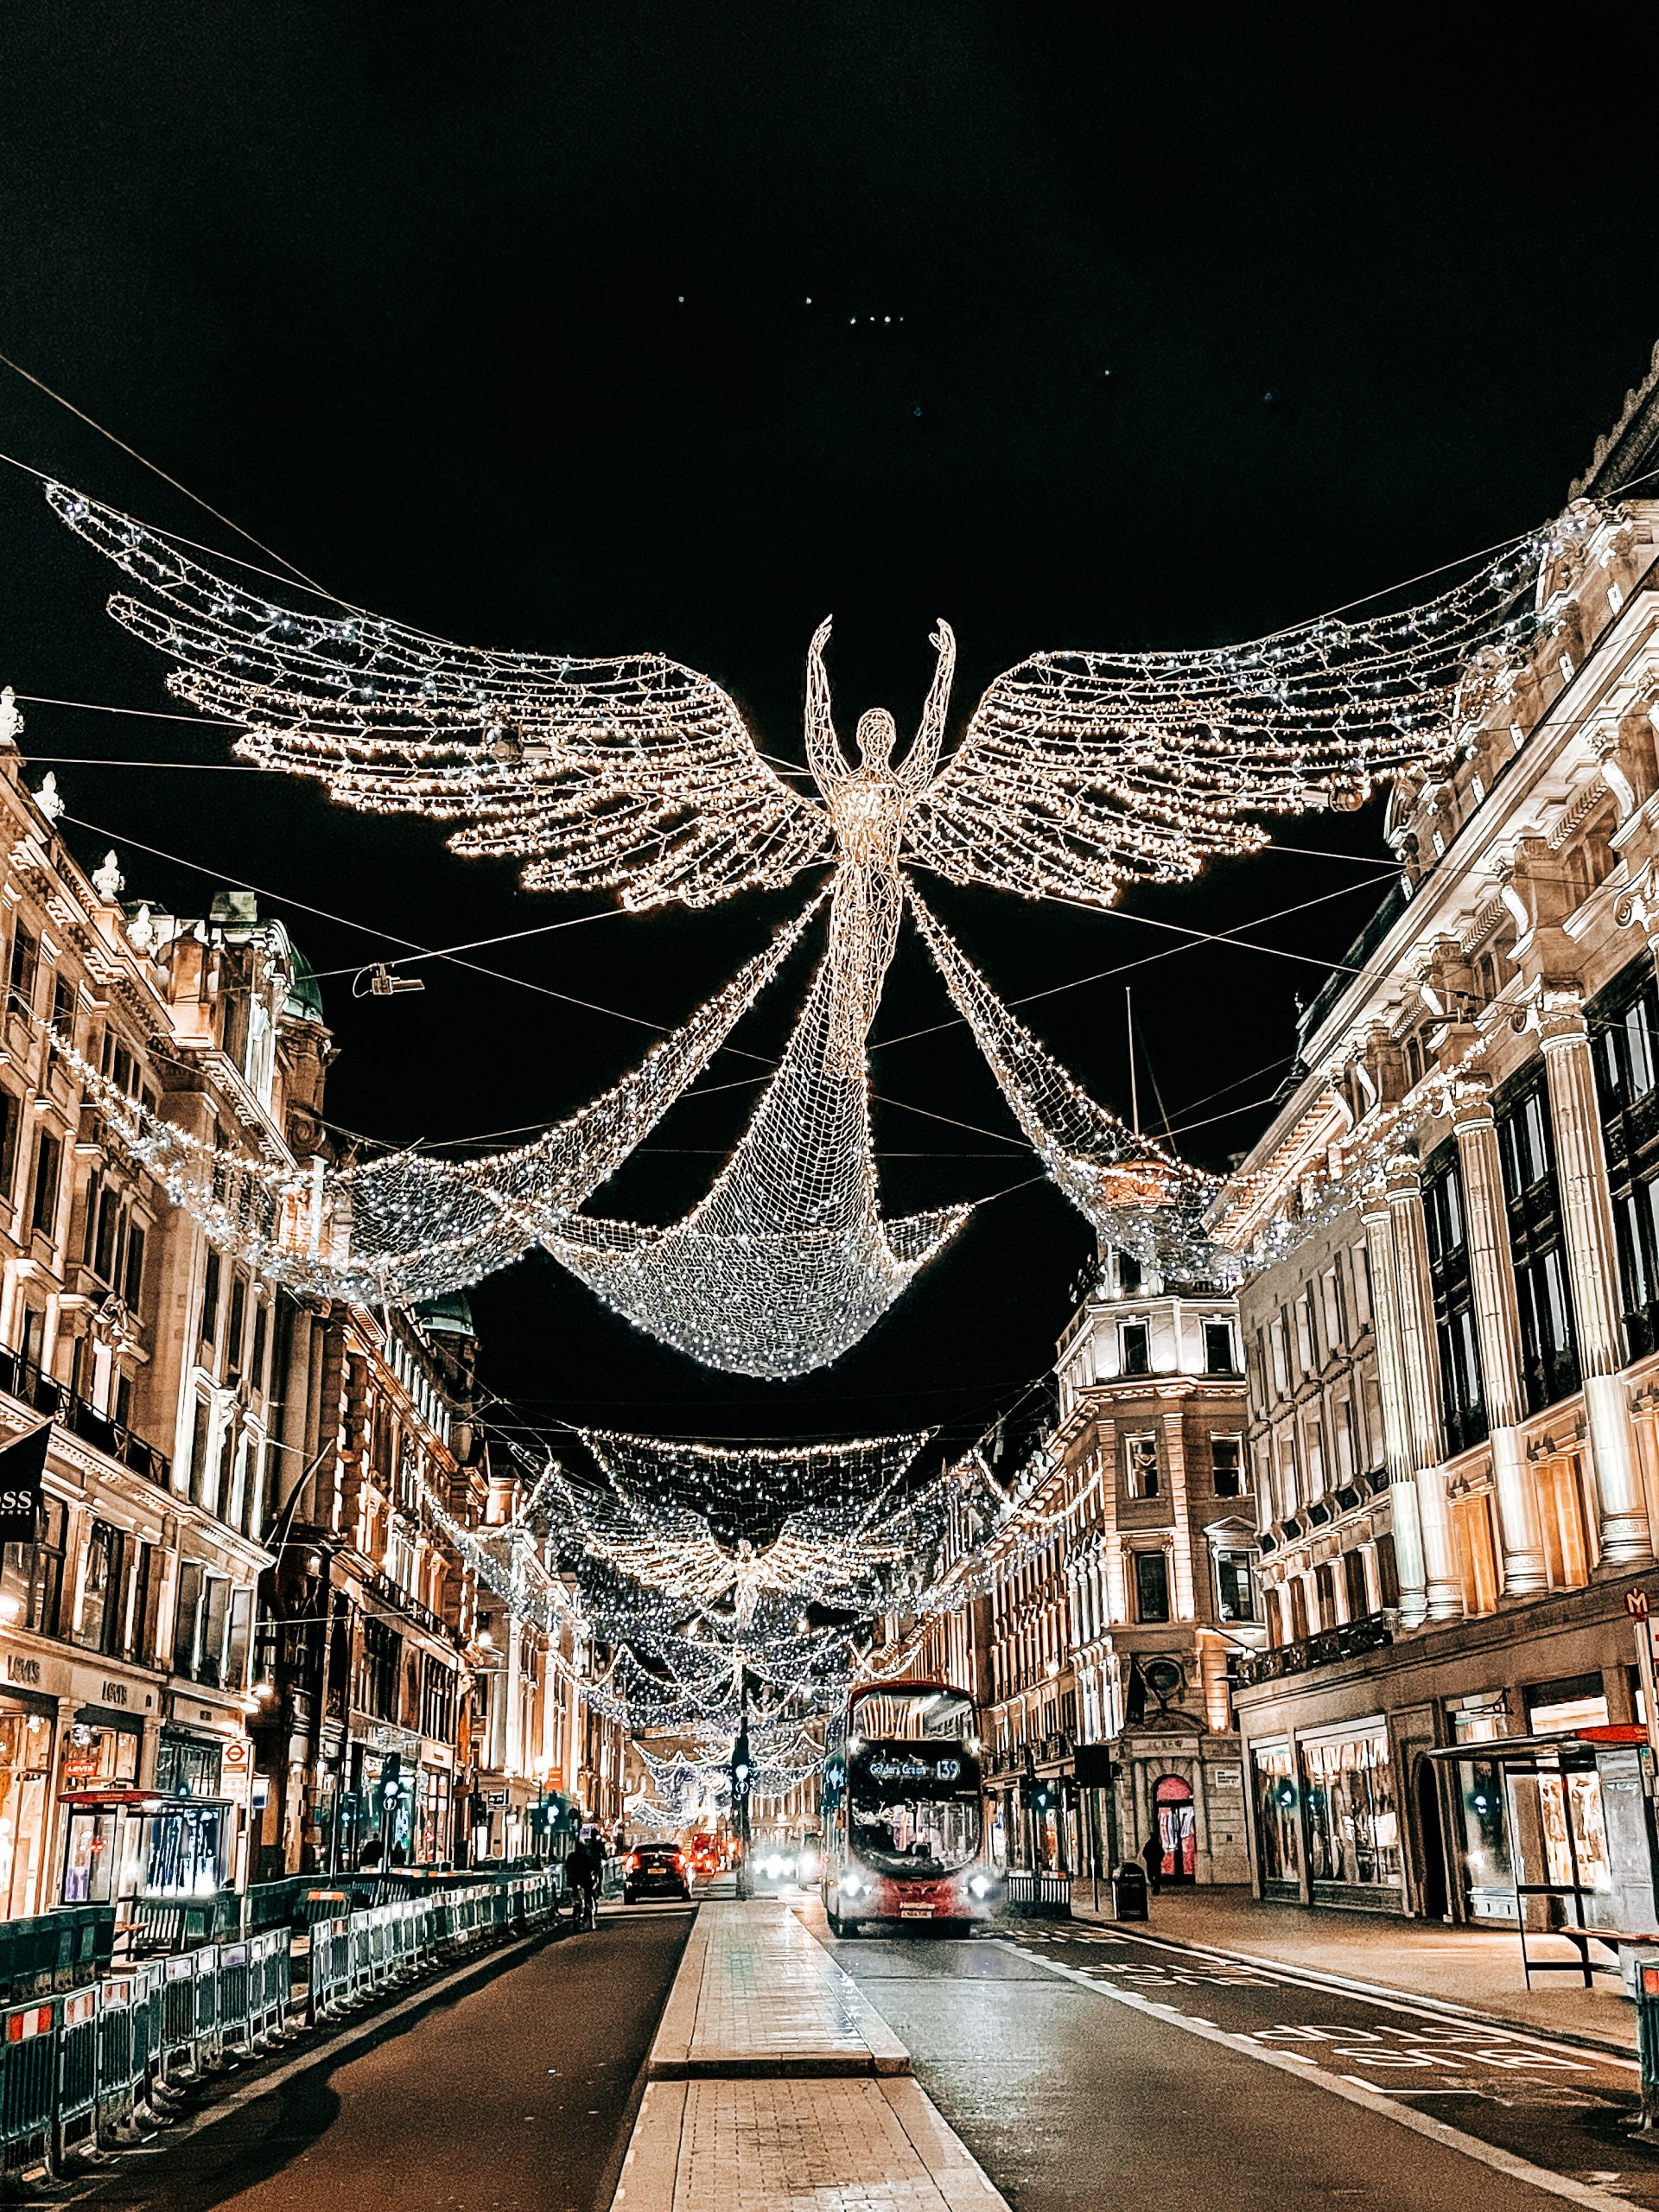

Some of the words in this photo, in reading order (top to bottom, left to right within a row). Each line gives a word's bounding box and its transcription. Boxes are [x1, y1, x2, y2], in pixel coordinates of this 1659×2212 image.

[902, 1764, 927, 1776] Green
[937, 1760, 960, 1780] 139
[1253, 2024, 1512, 2044] STOP
[1332, 2047, 1597, 2070] BUS
